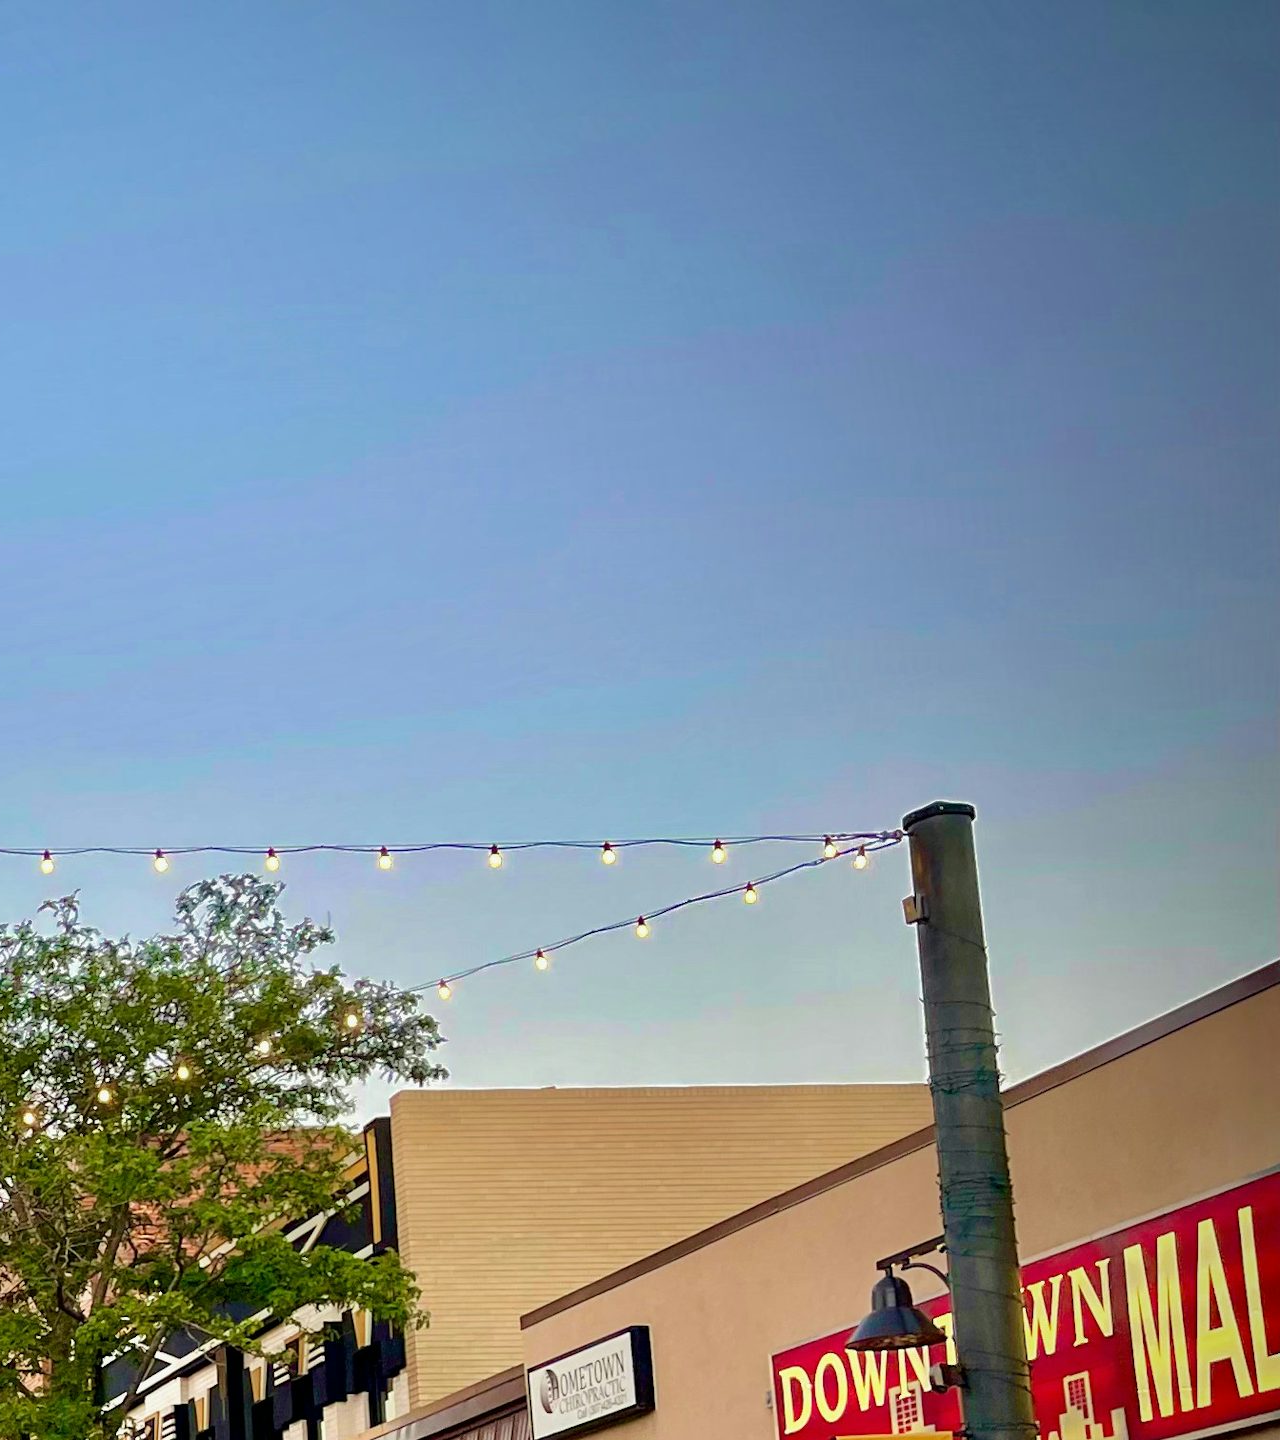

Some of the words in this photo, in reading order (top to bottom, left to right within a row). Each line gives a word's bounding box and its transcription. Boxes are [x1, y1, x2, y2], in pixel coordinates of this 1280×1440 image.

[779, 1257, 1115, 1434] DOWNTWN
[546, 1350, 625, 1401] HOMETOWN
[559, 1378, 626, 1415] CHIROPRACTIC
